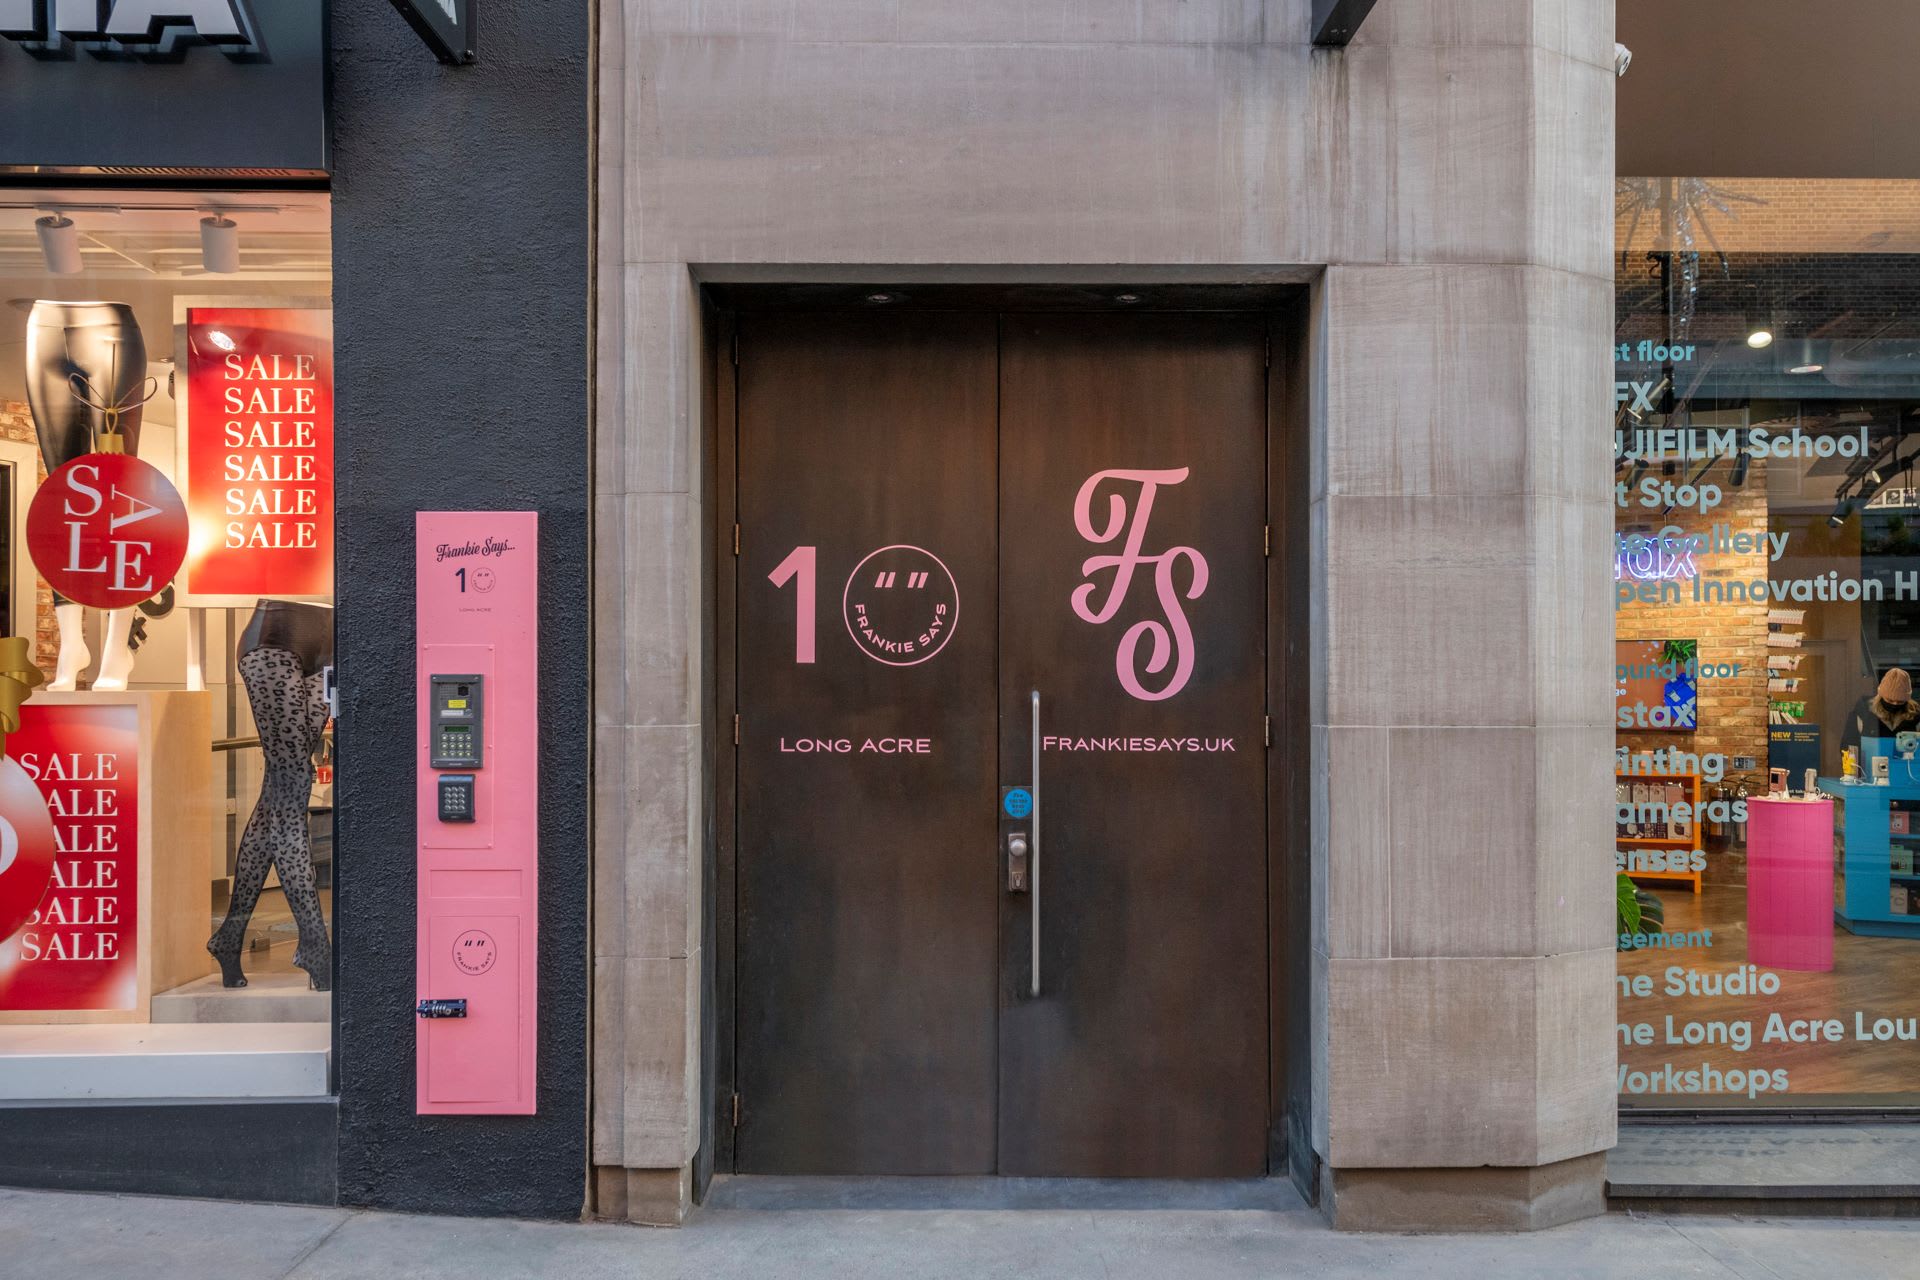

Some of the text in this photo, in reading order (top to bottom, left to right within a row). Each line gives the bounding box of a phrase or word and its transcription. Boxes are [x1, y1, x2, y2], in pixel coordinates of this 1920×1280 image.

[1637, 340, 1696, 361] floor
[224, 354, 316, 381] SALE
[224, 387, 316, 414] SALE
[224, 420, 316, 448] SALE
[1748, 426, 1869, 458] School
[224, 454, 316, 481] SALE
[225, 488, 317, 515] SALE
[1639, 477, 1723, 514] Stop
[225, 521, 317, 549] SALE
[1658, 523, 1790, 561] Gallery
[436, 541, 481, 562] Frankie
[1693, 570, 1883, 602] Innovation
[855, 603, 946, 653] FRANKIE SAYS
[1685, 657, 1743, 679] floor
[780, 737, 931, 753] LONG ACRE
[1043, 736, 1236, 752] FRANKIESAYS.UK
[20, 752, 118, 781] SALE
[1616, 745, 1725, 783] inting
[48, 788, 118, 817] ALE
[53, 824, 118, 853] ALE
[48, 861, 118, 889] ALE
[20, 932, 119, 961] SALE
[1616, 928, 1713, 949] sement
[1664, 964, 1781, 998] Studio
[1665, 1014, 1752, 1051] Long
[1762, 1012, 1845, 1043] Acre
[1855, 1011, 1917, 1041] Lou
